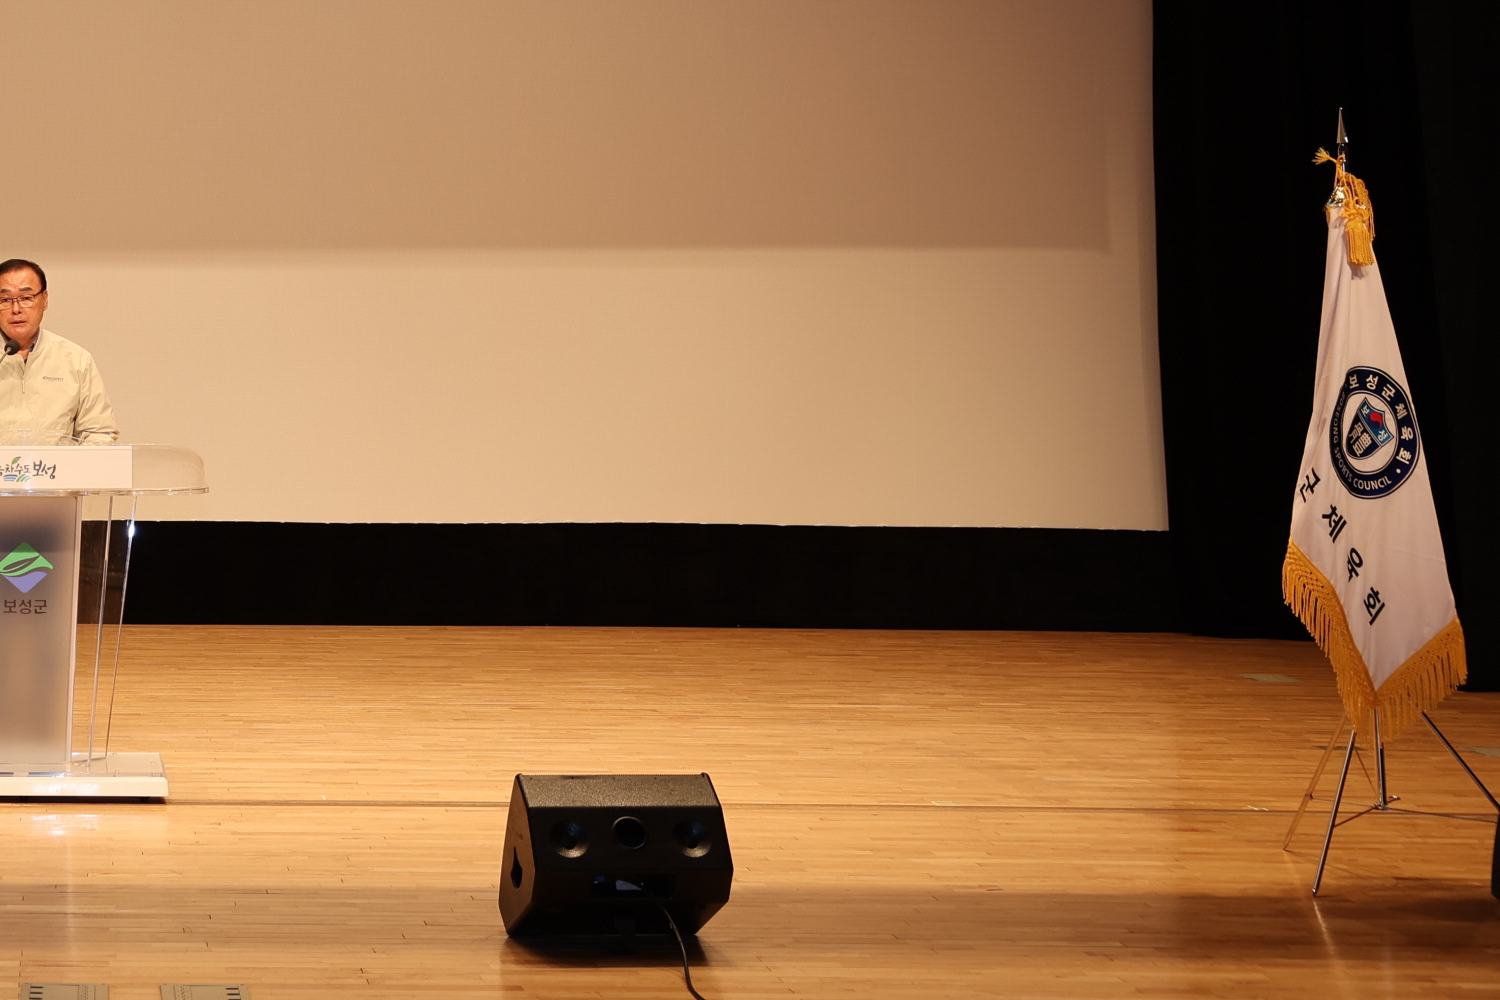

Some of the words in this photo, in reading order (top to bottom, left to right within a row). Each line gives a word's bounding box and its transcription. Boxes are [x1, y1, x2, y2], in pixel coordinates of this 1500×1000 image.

[32, 459, 57, 480] 보성
[1352, 475, 1393, 491] COUNCIL
[3, 599, 47, 615] 보성군
